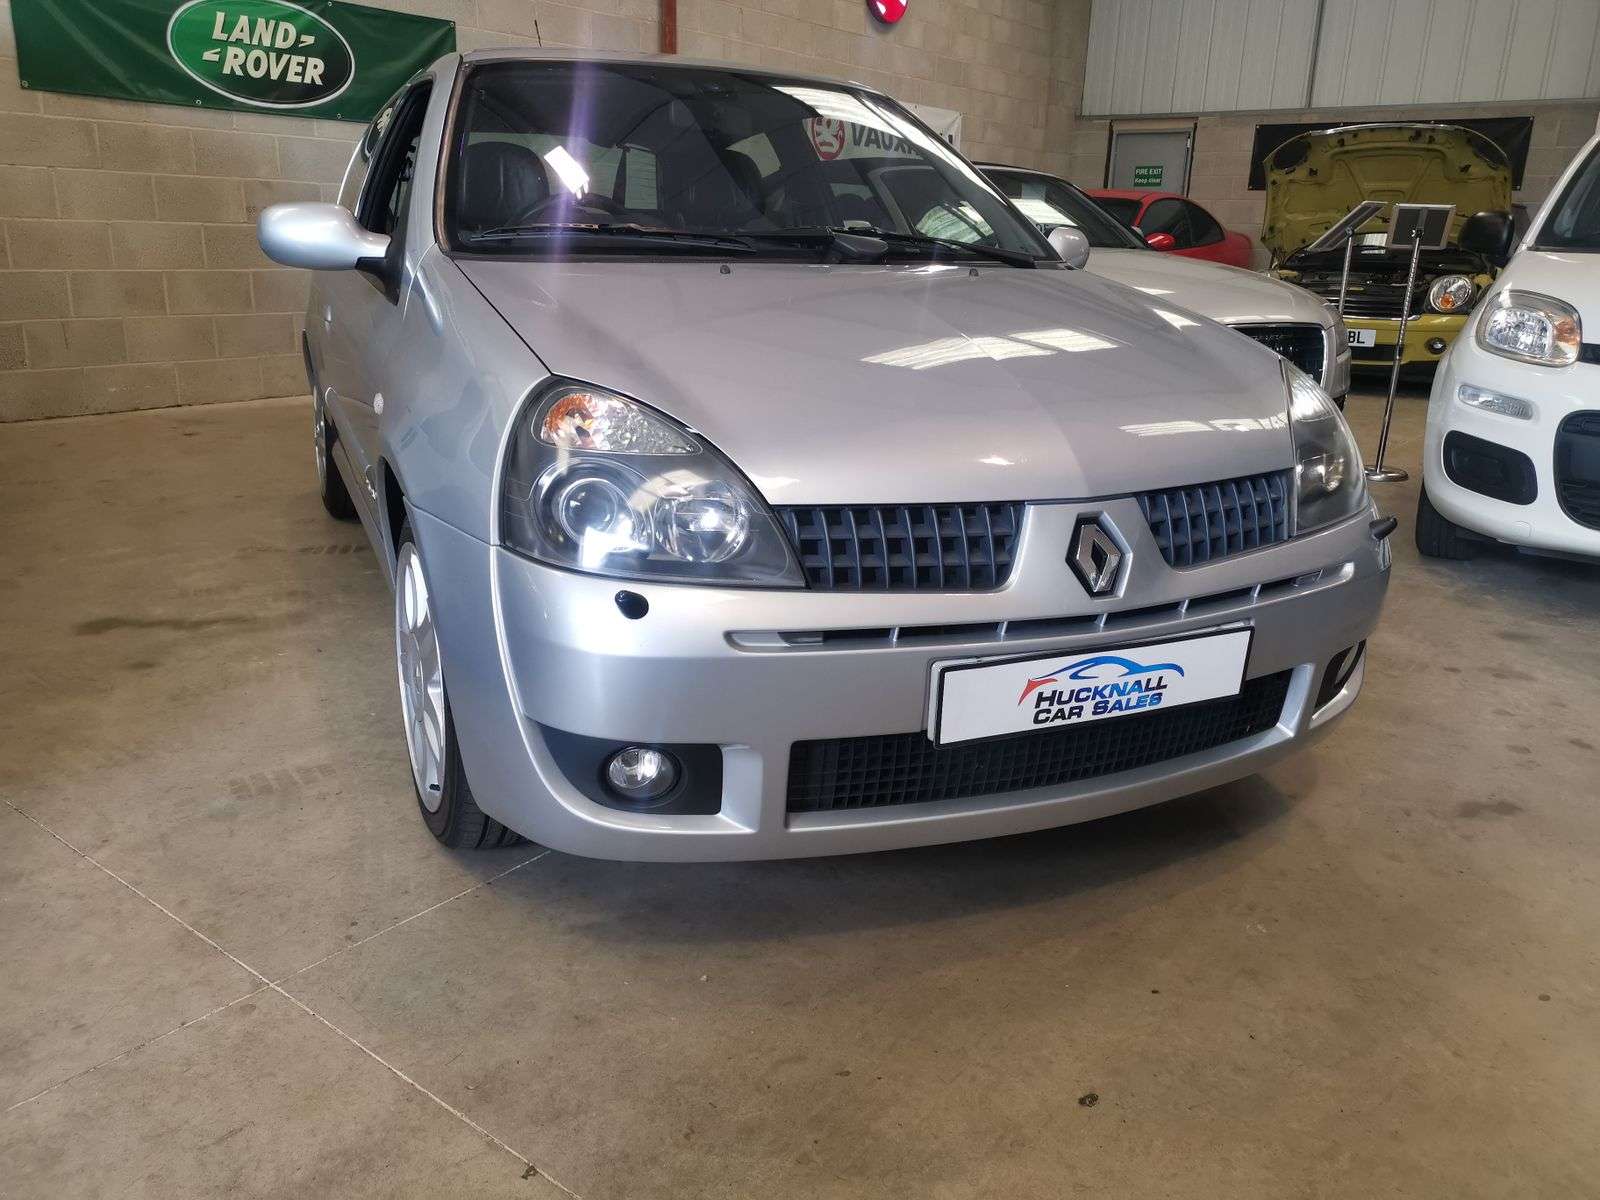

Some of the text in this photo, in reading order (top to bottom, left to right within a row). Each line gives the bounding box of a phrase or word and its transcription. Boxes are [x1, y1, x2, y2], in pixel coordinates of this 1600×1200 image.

[211, 10, 297, 49] LAND
[222, 45, 325, 86] ROVER
[851, 121, 920, 156] VAUX
[1347, 330, 1366, 344] BL
[1033, 692, 1164, 725] CAR SALES
[1034, 675, 1168, 709] HUCKNALL
